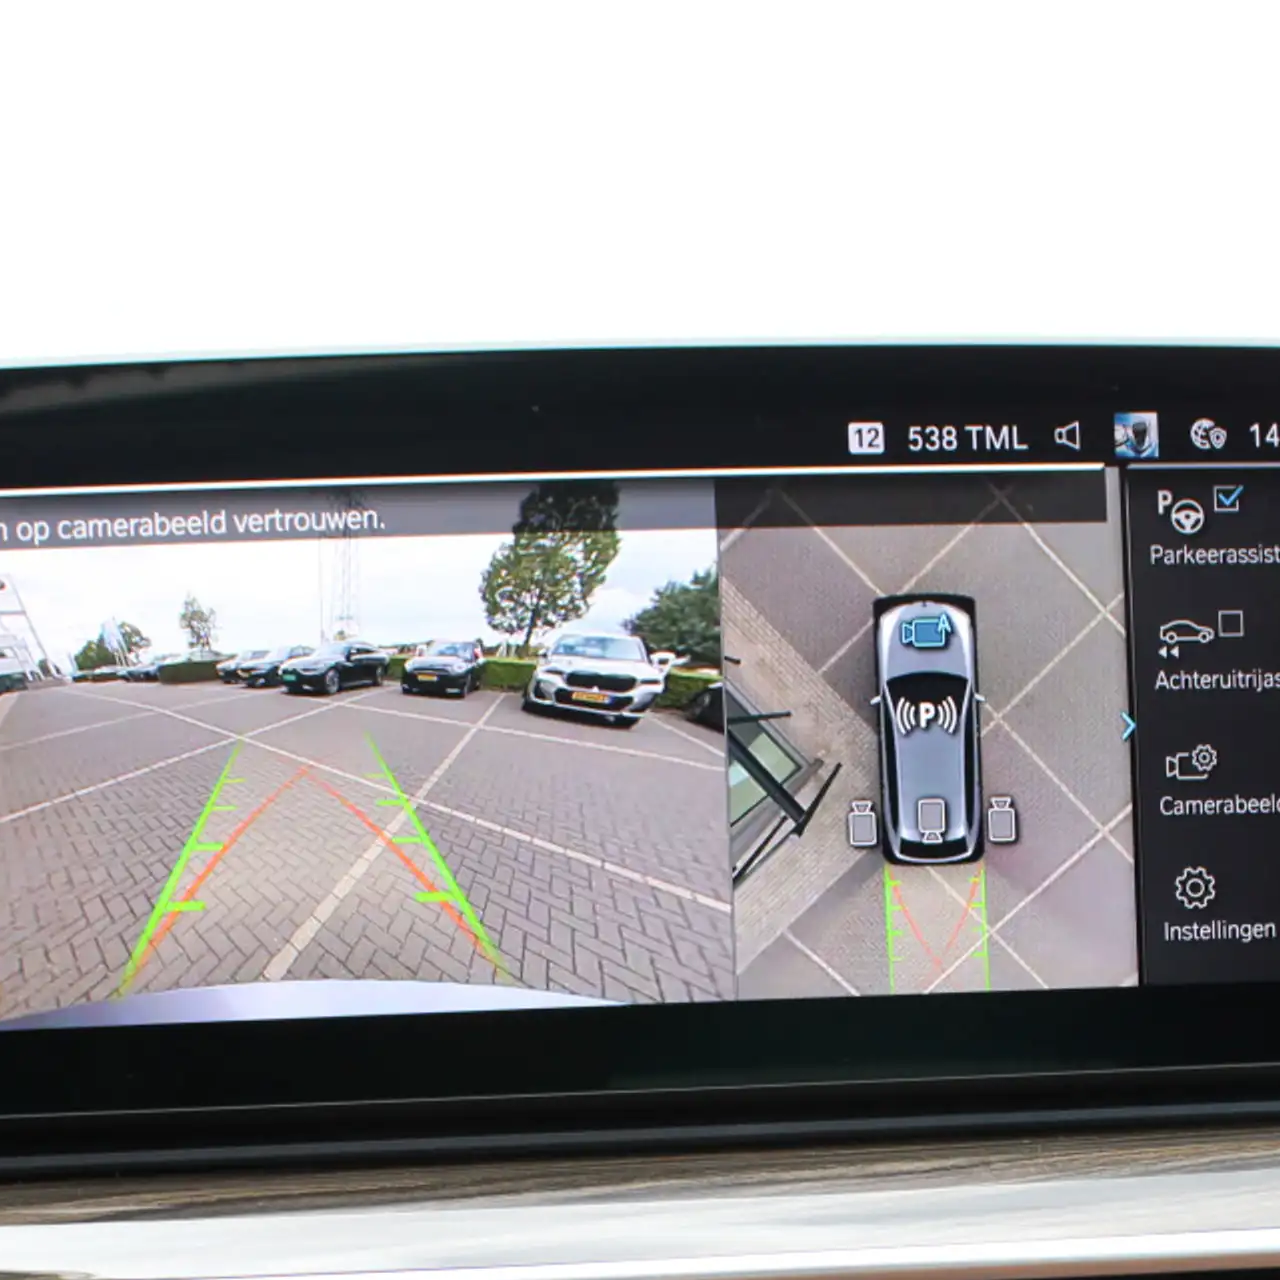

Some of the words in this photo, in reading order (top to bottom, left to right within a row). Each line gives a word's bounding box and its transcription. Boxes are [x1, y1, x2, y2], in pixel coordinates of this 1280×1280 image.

[854, 427, 880, 450] 12
[907, 425, 958, 452] 538
[964, 425, 1029, 451] TML
[15, 520, 50, 546] op
[56, 509, 228, 539] camerabeeld
[232, 507, 386, 533] vertrouwen.
[1163, 919, 1277, 943] Instellingen
